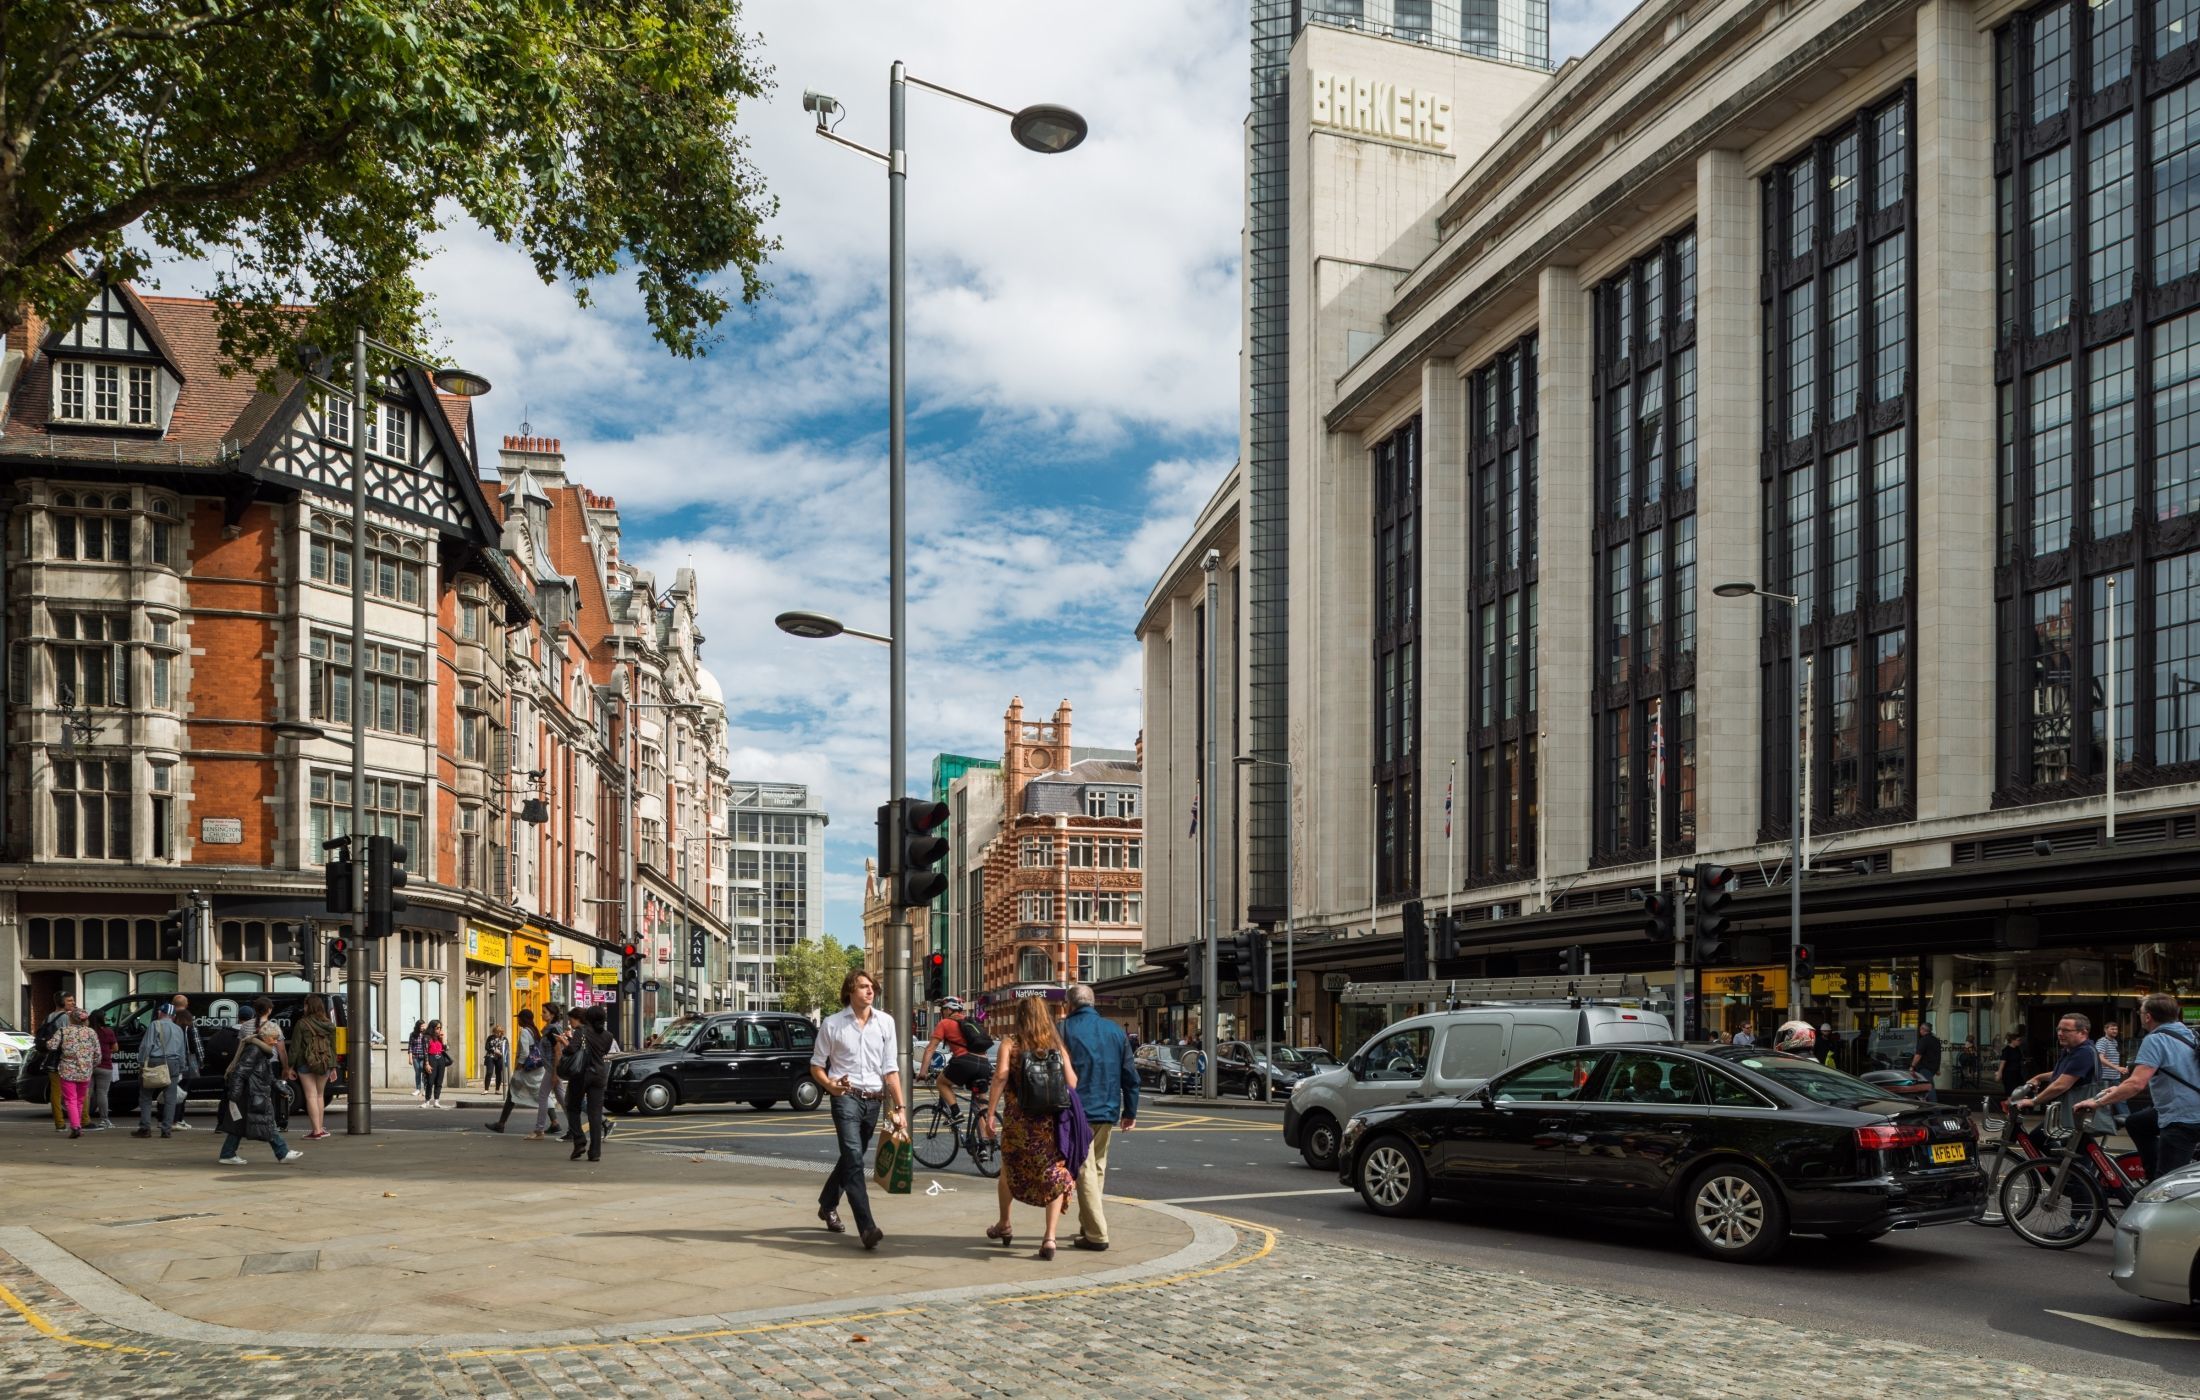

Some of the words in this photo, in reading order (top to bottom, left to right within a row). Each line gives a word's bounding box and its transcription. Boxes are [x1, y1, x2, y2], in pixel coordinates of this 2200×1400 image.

[1310, 69, 1453, 151] BARKERS
[693, 930, 702, 963] ZARA
[1015, 989, 1047, 998] NatWest
[1934, 1146, 1951, 1160] KF16
